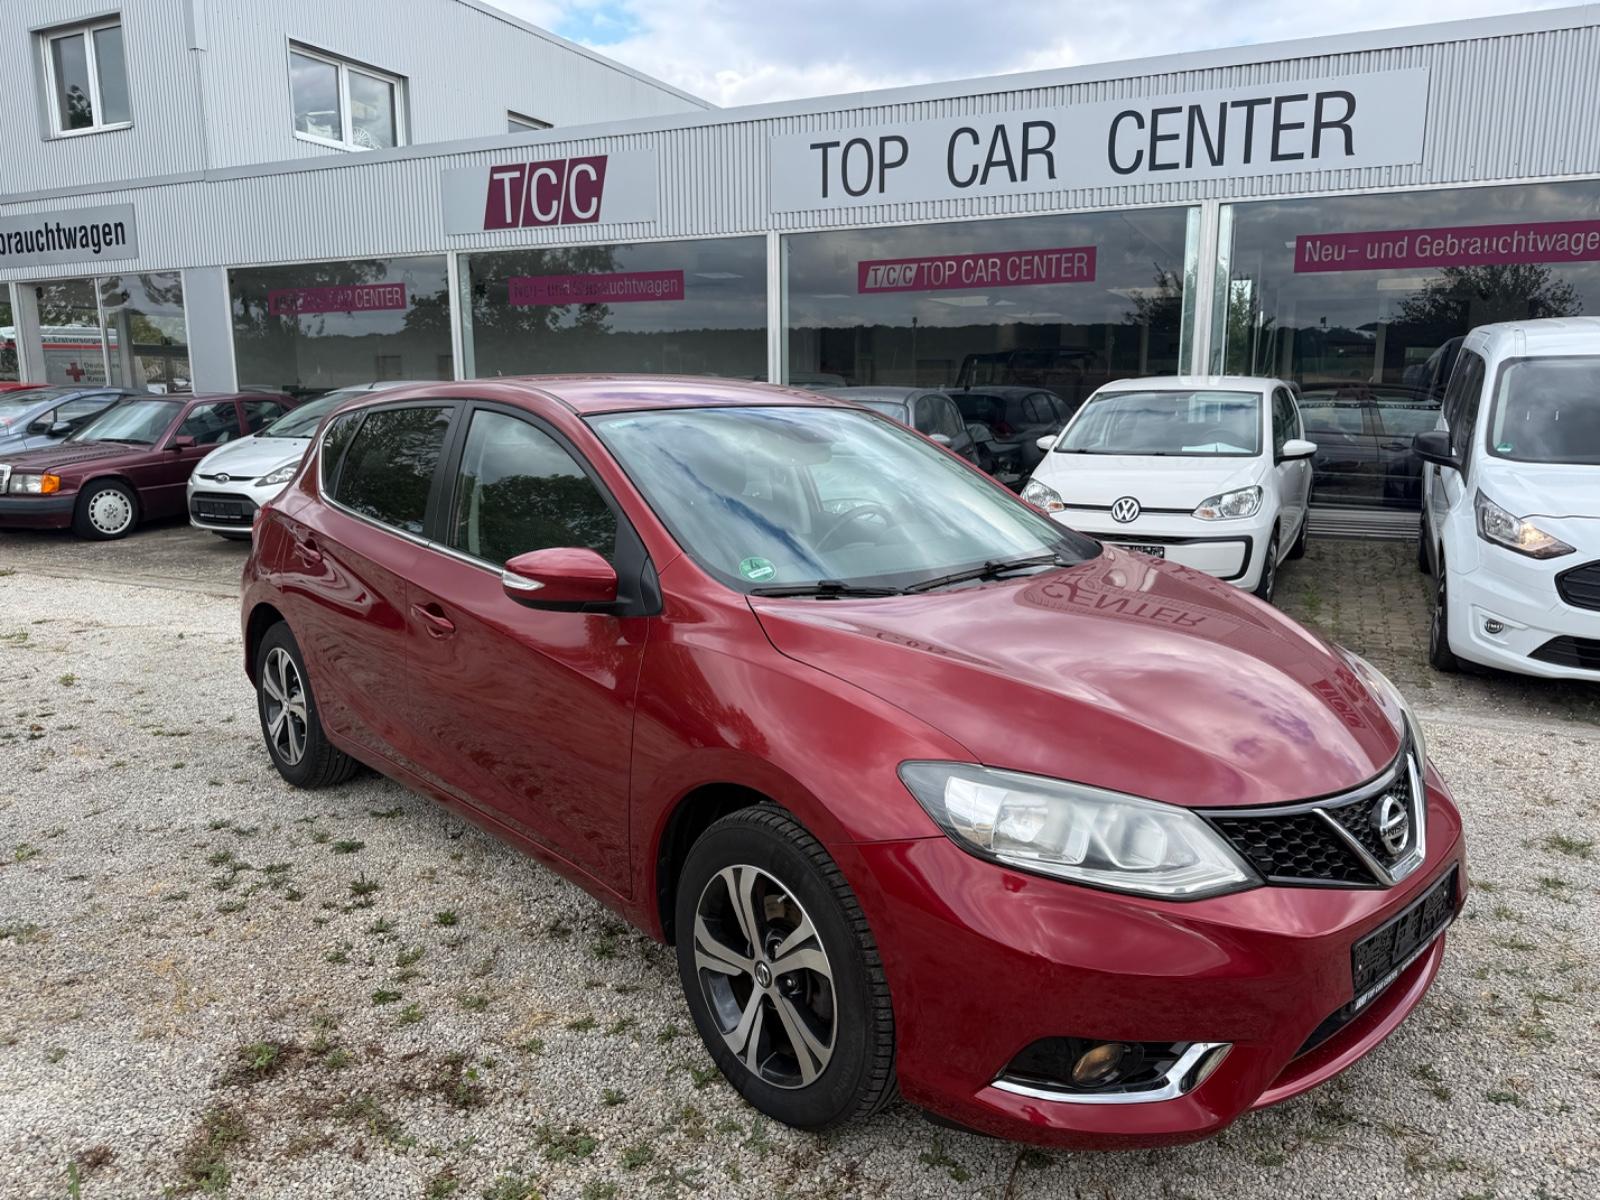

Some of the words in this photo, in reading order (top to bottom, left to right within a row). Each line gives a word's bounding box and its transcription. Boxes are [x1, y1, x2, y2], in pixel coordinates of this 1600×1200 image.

[809, 135, 909, 198] TOP
[947, 120, 1057, 188] CAR
[1107, 90, 1357, 175] CENTER
[1304, 240, 1359, 263] Neu-
[1366, 236, 1408, 260] und
[920, 260, 957, 286] TOP
[961, 258, 1001, 284] CAR
[1006, 253, 1088, 281] CENTER
[354, 287, 402, 308] CENTER
